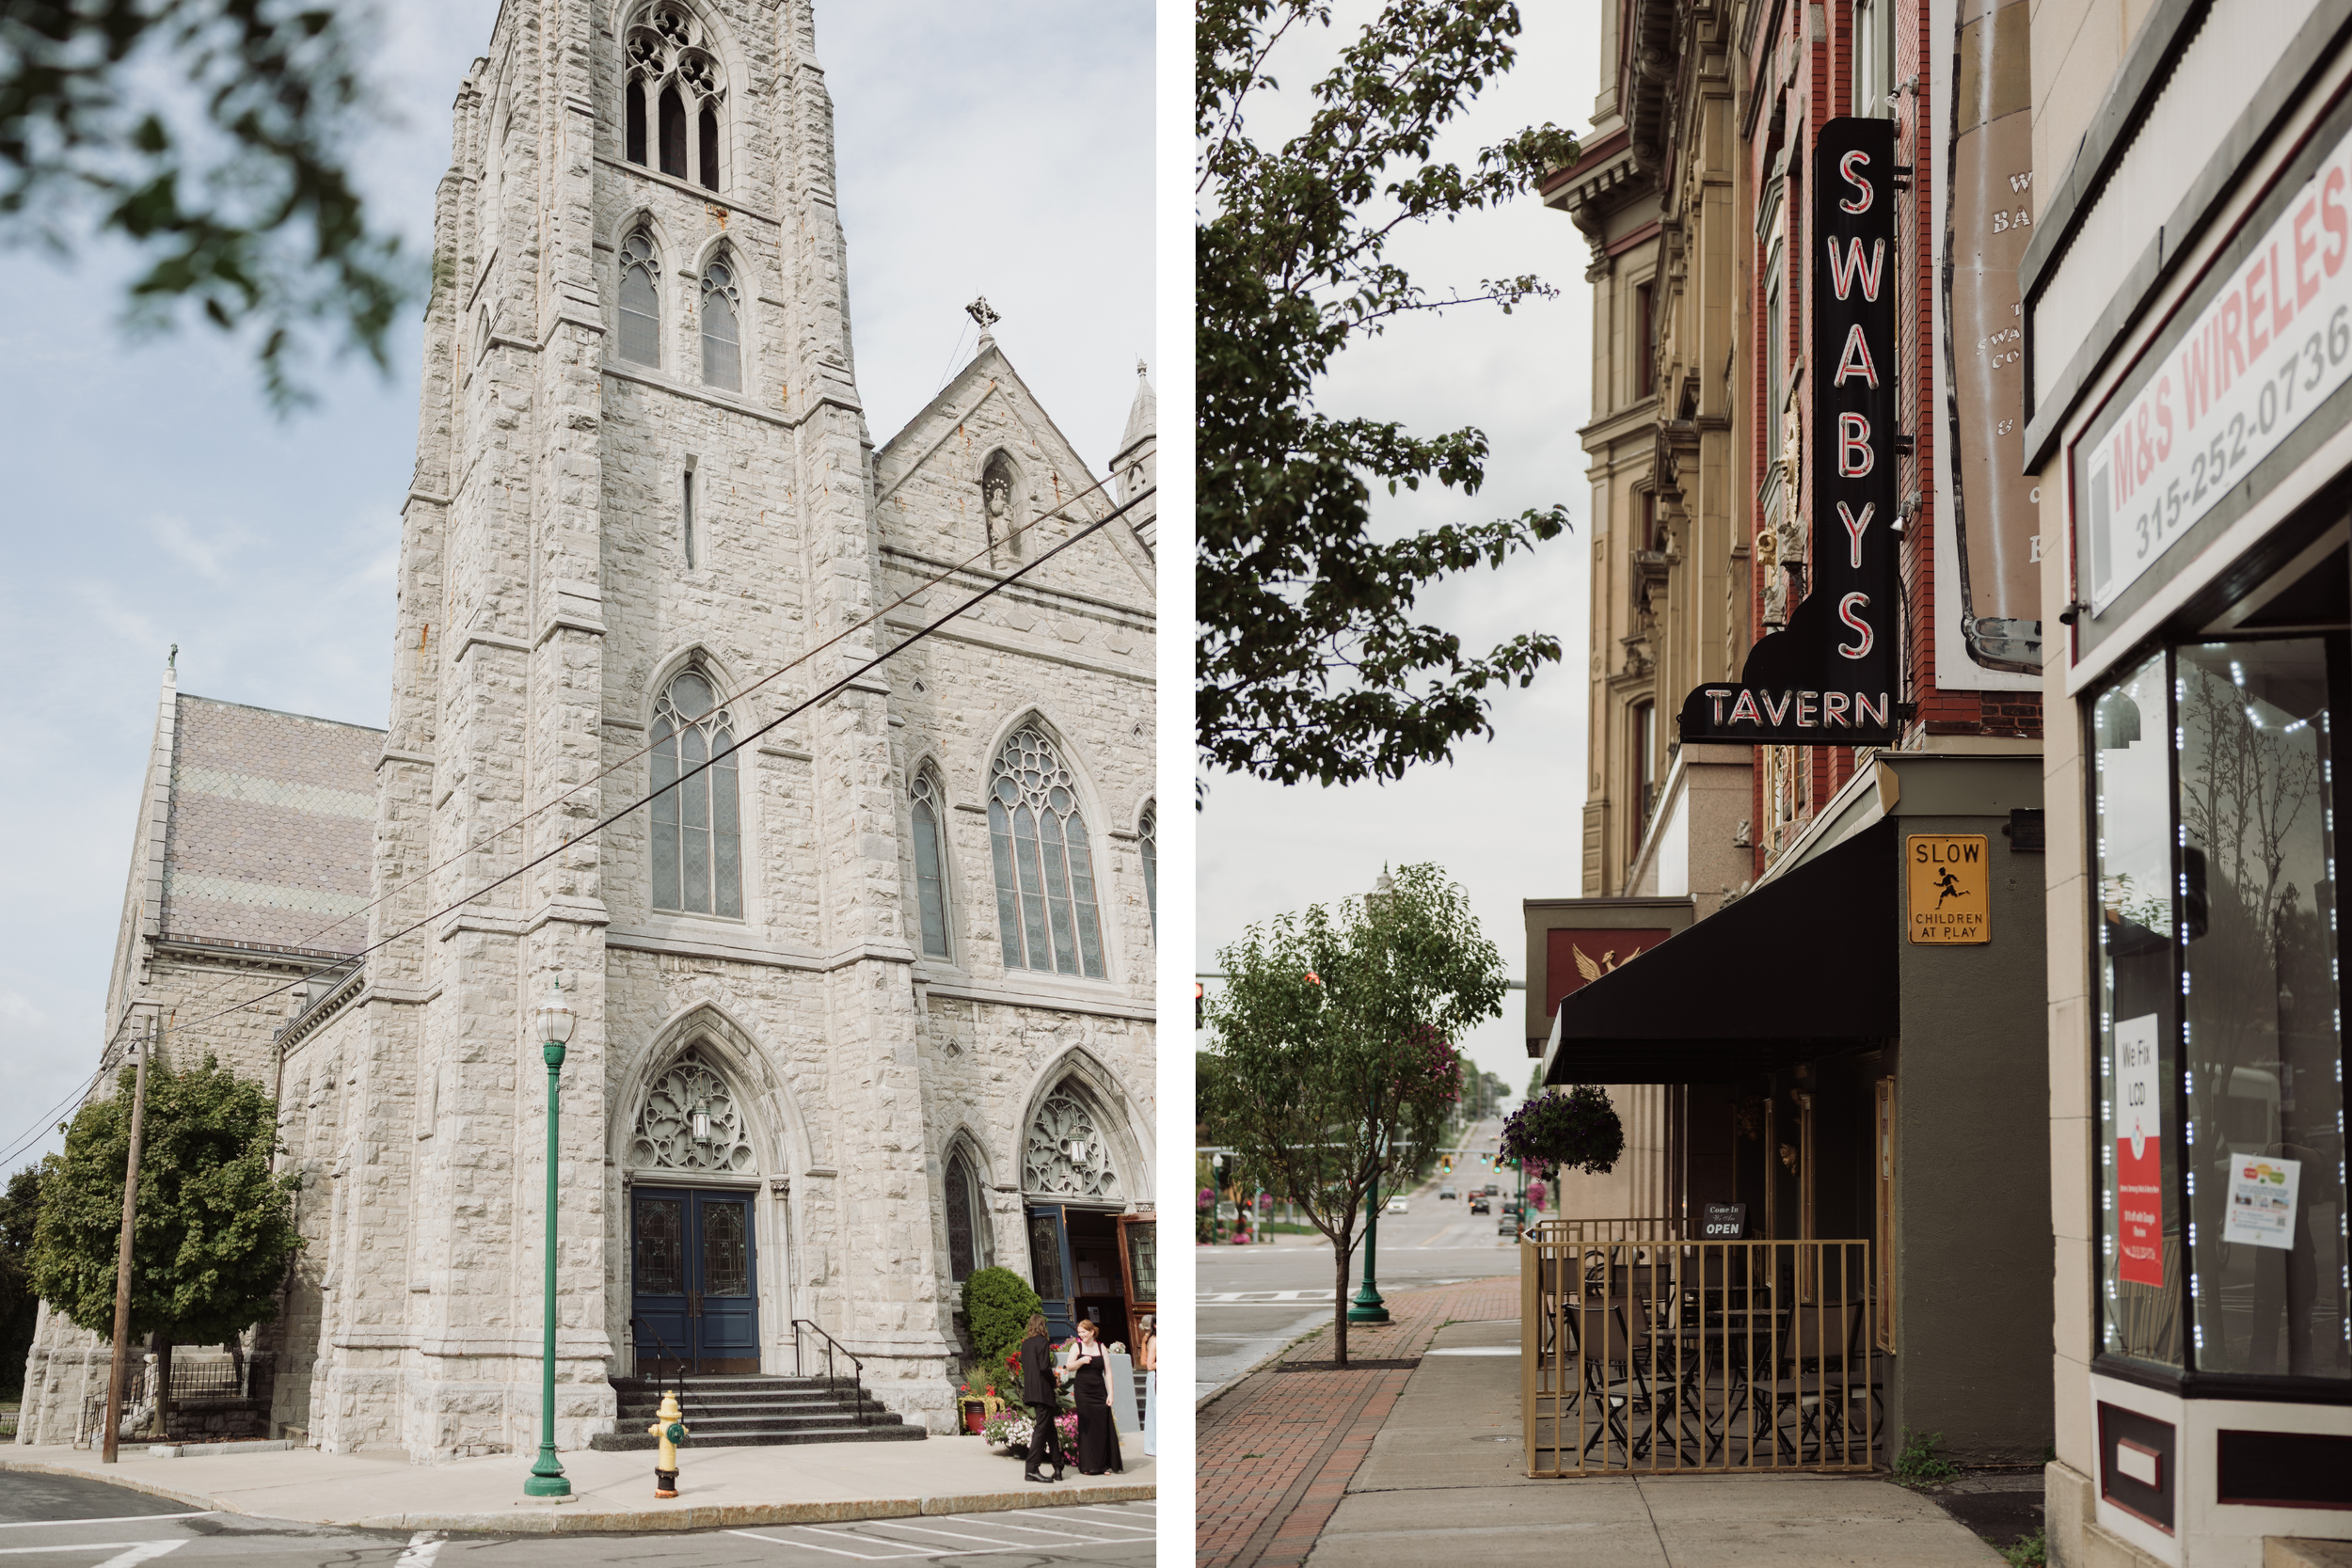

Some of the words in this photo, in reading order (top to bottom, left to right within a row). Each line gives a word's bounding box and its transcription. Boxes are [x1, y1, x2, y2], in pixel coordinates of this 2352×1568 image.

[2112, 374, 2174, 513] M&S
[2181, 160, 2352, 432] WIRELES
[1827, 150, 1885, 659] SWABYS
[2137, 304, 2351, 561] 315-252-0736
[1705, 689, 1889, 729] TAVERN
[1915, 843, 1979, 863] SLOW
[1915, 913, 1982, 924] CHILDREN
[1921, 927, 1936, 938] AT
[1944, 927, 1978, 938] PLAY
[2122, 1041, 2136, 1069] We
[2137, 1039, 2152, 1067] Fix
[2128, 1082, 2146, 1106] LCD
[1706, 1224, 1740, 1234] OPEN
